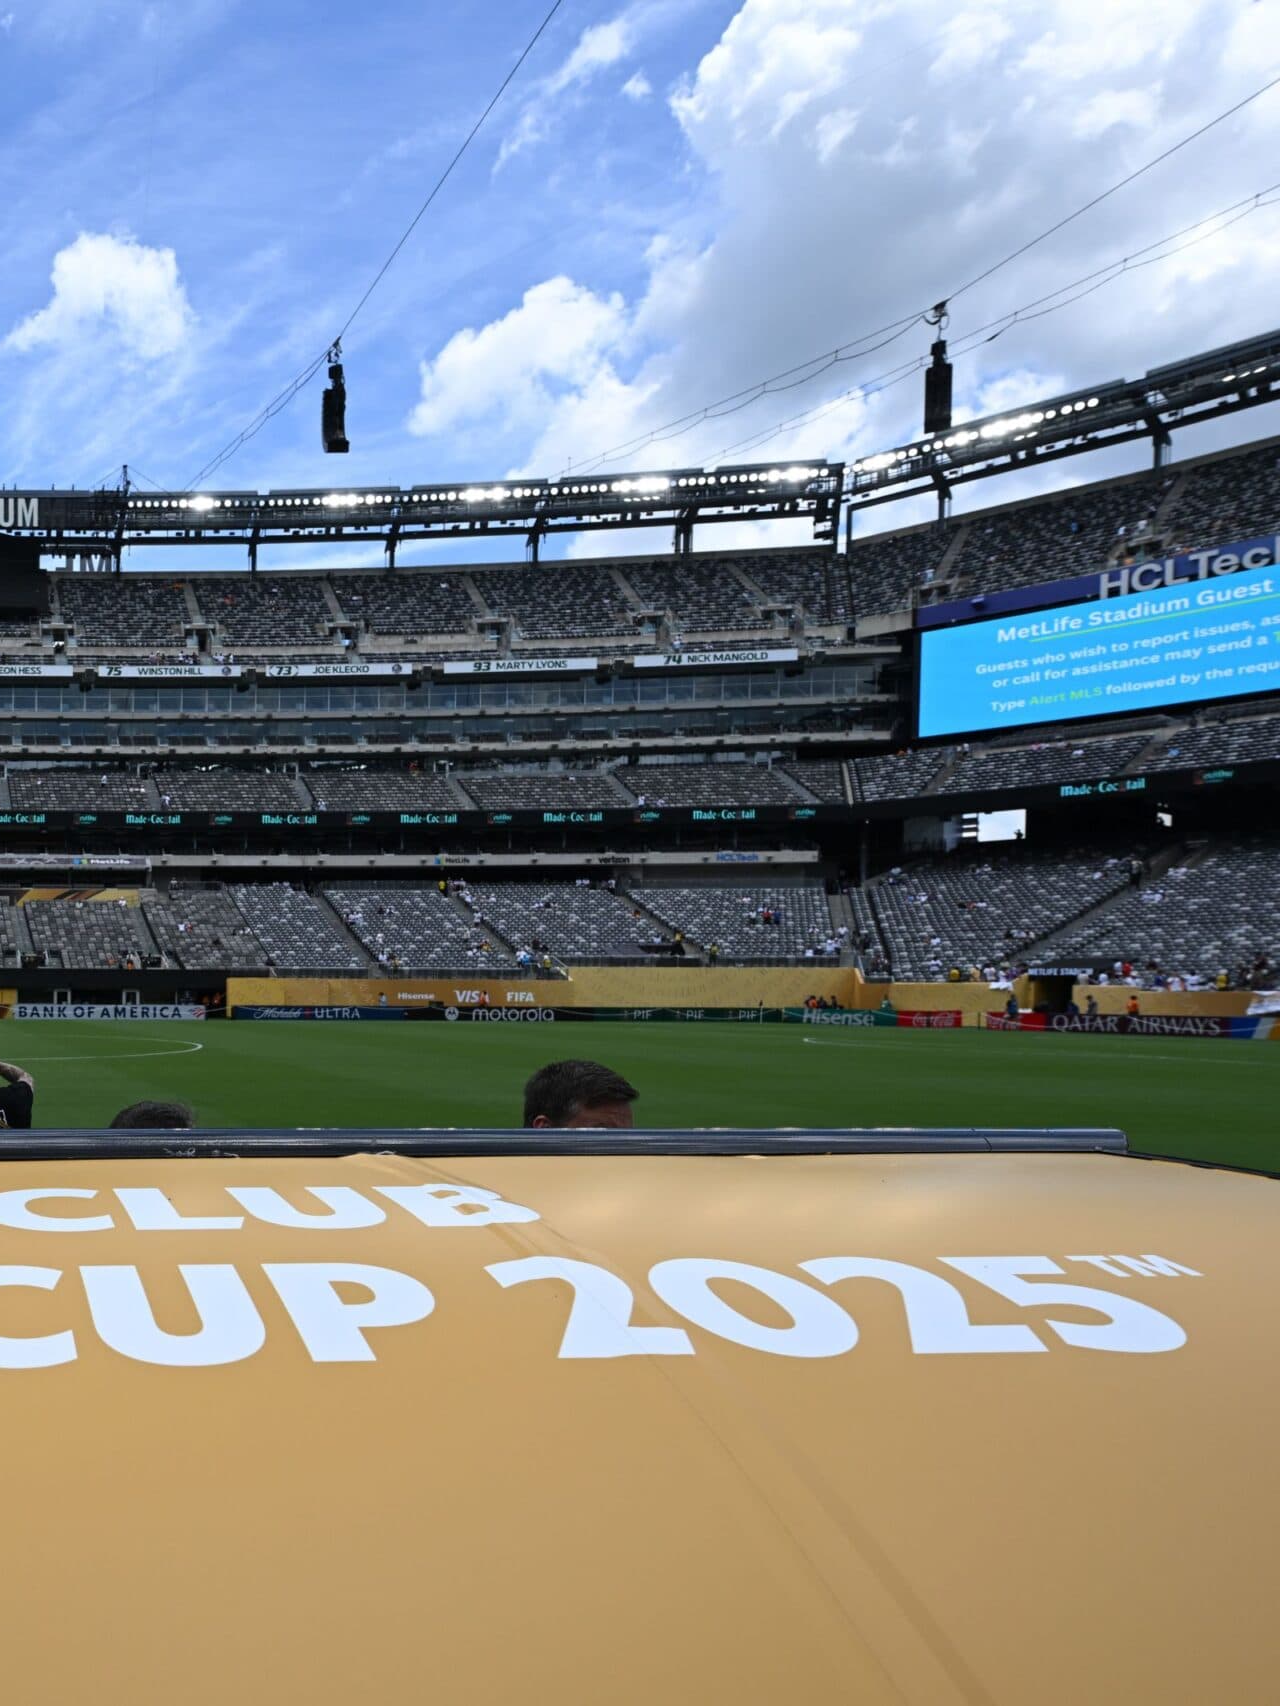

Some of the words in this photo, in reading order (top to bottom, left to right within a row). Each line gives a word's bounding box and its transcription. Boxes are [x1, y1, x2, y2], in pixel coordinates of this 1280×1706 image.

[997, 616, 1083, 643] MetLife
[1088, 597, 1190, 627] Stadium
[1197, 579, 1274, 605] Guest
[975, 658, 1029, 675] Guests
[1032, 653, 1066, 666] who
[1069, 644, 1107, 659] wish
[1111, 642, 1129, 653] to
[1133, 629, 1191, 649] report
[1194, 619, 1256, 638] issues,
[687, 653, 711, 663] NICK
[713, 651, 768, 662] MANGOLD
[991, 678, 1009, 689] or
[1012, 671, 1041, 685] call
[1044, 669, 1068, 681] for
[1071, 653, 1161, 676] assistance
[1164, 647, 1203, 661] may
[1207, 635, 1252, 654] send
[1256, 635, 1268, 645] a
[18, 667, 42, 675] HESS
[106, 666, 122, 676] 75
[137, 667, 178, 676] WINSTON
[178, 667, 204, 676] HILL
[275, 665, 293, 676] 73
[312, 665, 334, 674] JOE
[333, 664, 370, 674] KLECKO
[472, 661, 491, 672] 93
[495, 660, 533, 671] MARTY
[534, 659, 568, 670] LYONS
[990, 699, 1026, 713] Type
[1105, 674, 1177, 696] followed
[1180, 673, 1202, 685] by
[1205, 667, 1233, 680] the
[397, 991, 435, 1000] Hisense
[506, 991, 535, 1002] FIFA
[18, 1006, 68, 1019] BANK
[73, 1006, 95, 1018] OF
[100, 1006, 183, 1019] AMERICA
[314, 1007, 361, 1019] ULTRA
[471, 1007, 555, 1022] motorola
[802, 1008, 874, 1026] Hisense
[1052, 1014, 1119, 1032] QATAR
[1127, 1016, 1221, 1036] AIRWAYS
